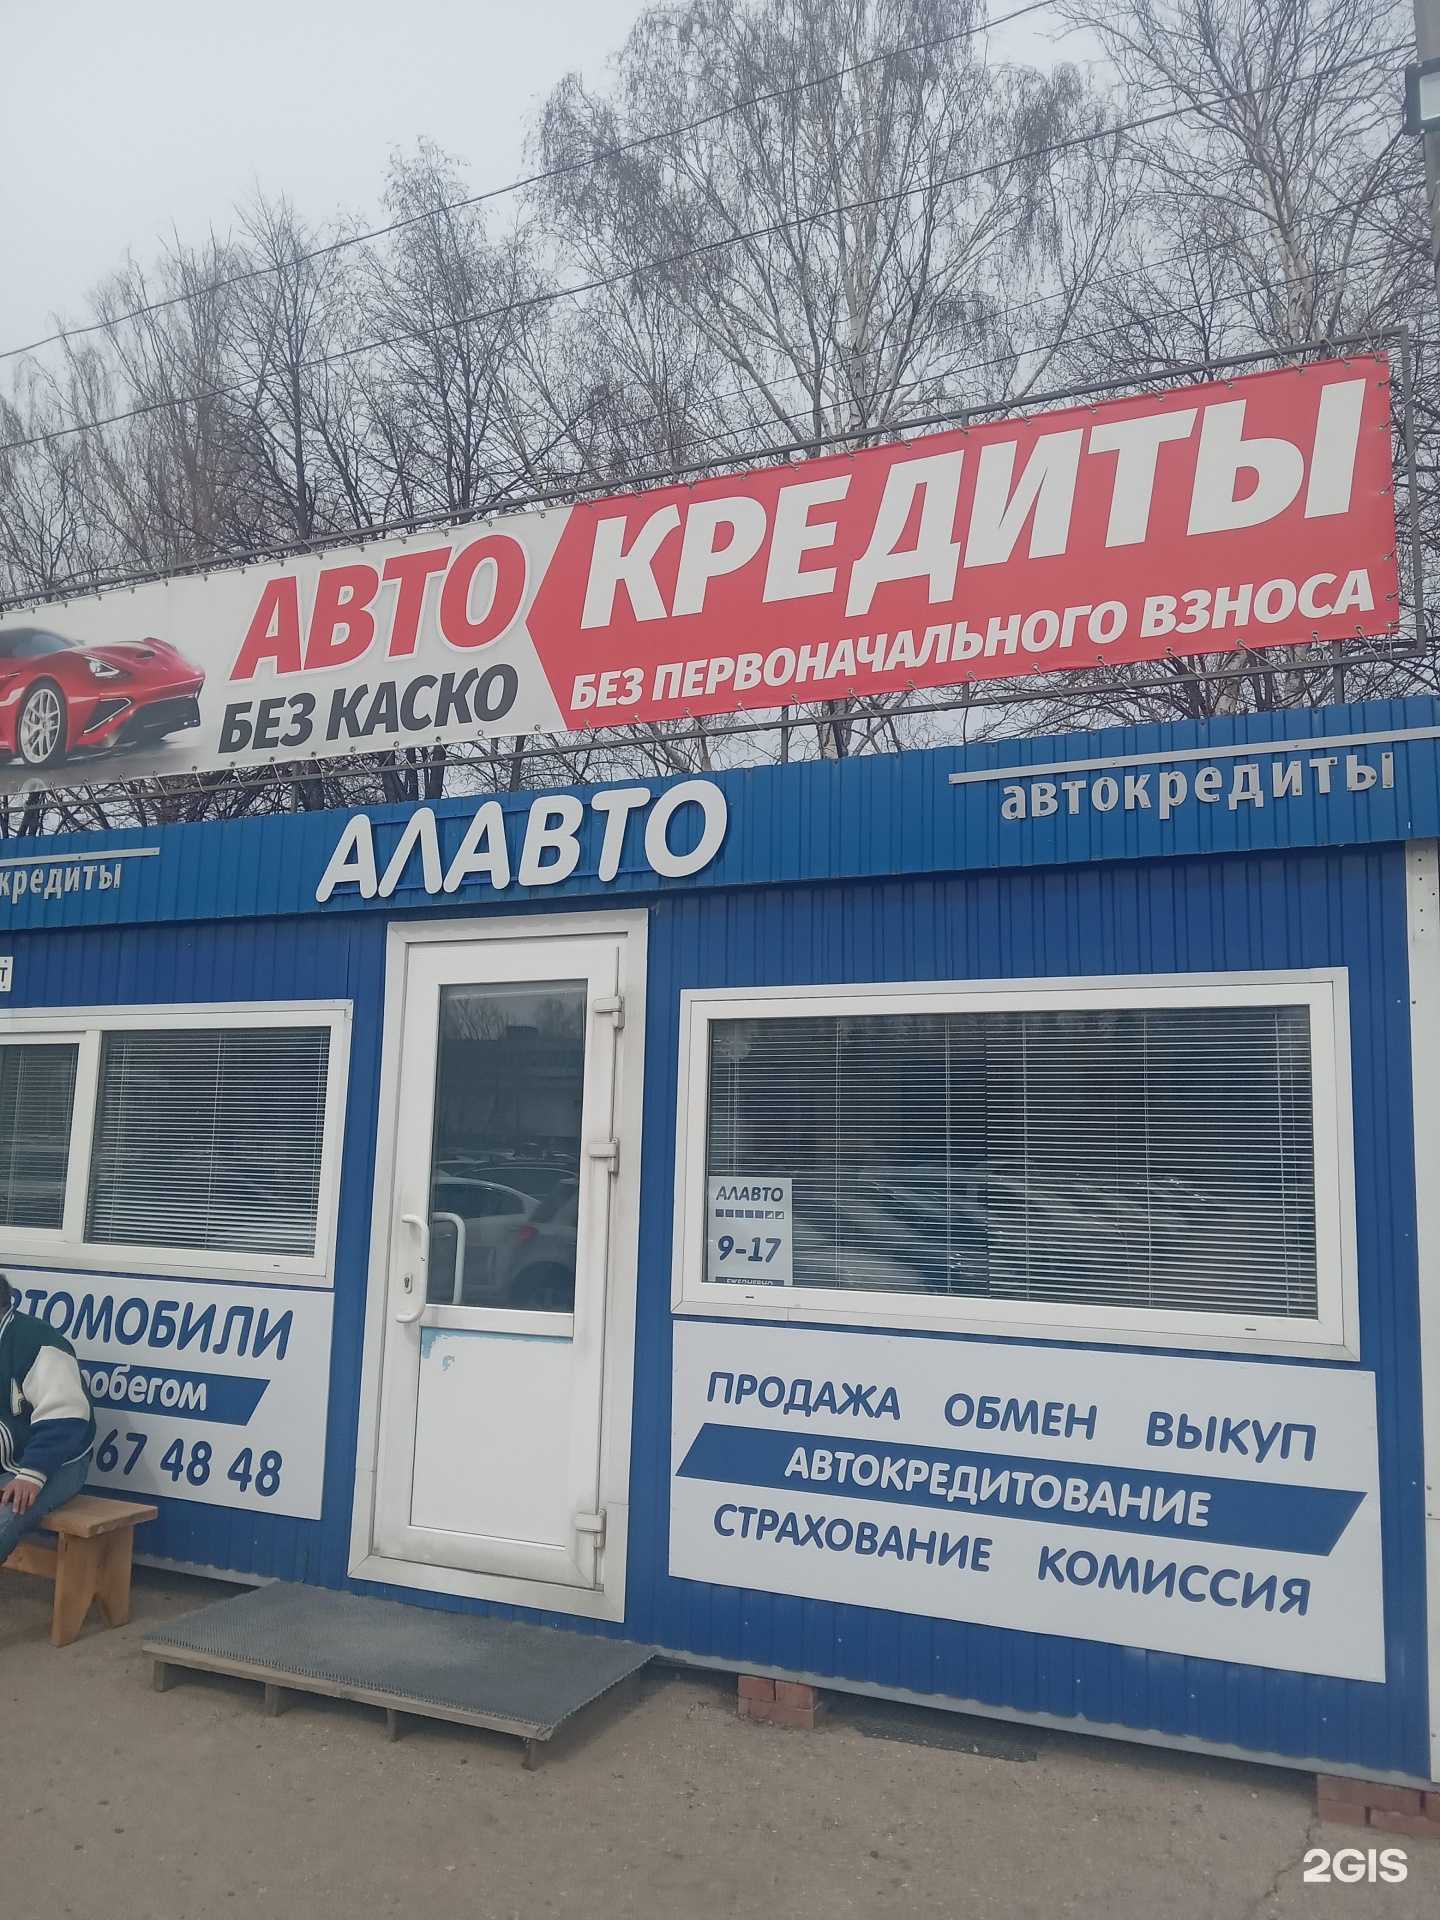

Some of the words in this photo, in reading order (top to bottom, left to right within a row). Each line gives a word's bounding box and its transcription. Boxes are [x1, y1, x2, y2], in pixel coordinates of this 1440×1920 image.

[229, 533, 527, 681] АВТО
[580, 378, 1367, 630] КРЕДИТЫ
[570, 667, 643, 711] БЕЗ
[652, 600, 1127, 701] ПЕРВОНАЧАЛЬНОГО
[1139, 568, 1375, 639] ВЗНОСА
[218, 691, 314, 754] БЕЗ
[329, 663, 519, 737] КАСКО
[1000, 751, 1395, 820] автокредиты
[316, 779, 728, 902] АЛАВТО
[716, 1186, 784, 1202] АЛАВТО
[718, 1235, 782, 1263] 9-17
[706, 1371, 901, 1419] ПРОДАЖА
[944, 1393, 1098, 1440] ОБМЕН
[1146, 1410, 1318, 1463] ВЫКУП
[90, 1429, 148, 1476] 67
[160, 1438, 213, 1487] 48
[227, 1447, 283, 1497] 48
[784, 1447, 1212, 1528] АВТОКРЕДИТОВАНИЕ
[713, 1503, 993, 1573] СТРАХОВАНИЕ
[1038, 1545, 1312, 1616] КОМИССИЯ
